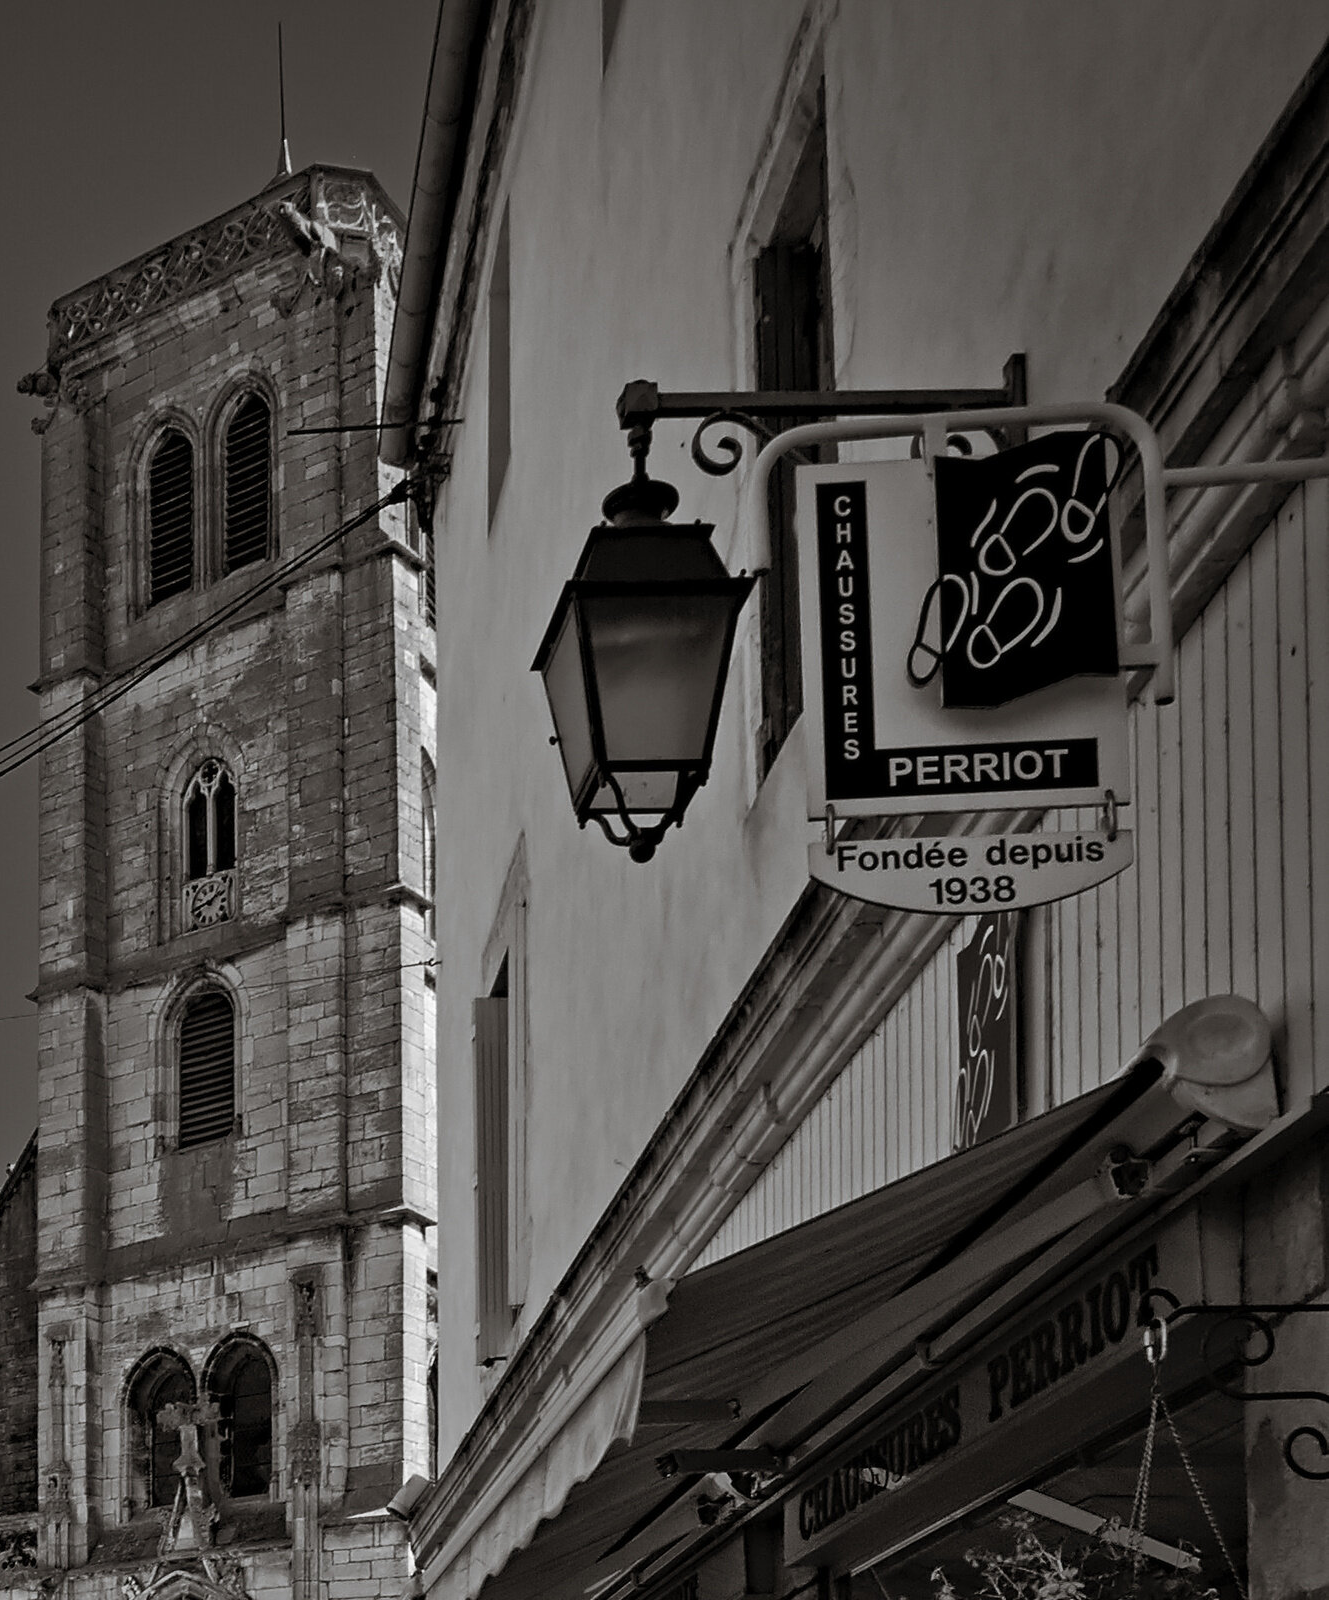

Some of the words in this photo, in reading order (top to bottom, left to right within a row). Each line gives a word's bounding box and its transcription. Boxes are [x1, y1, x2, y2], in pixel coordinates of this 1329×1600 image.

[832, 495, 862, 761] CHAUSSURES
[889, 749, 1069, 787] PERRIOT
[837, 839, 969, 873] Fondée
[985, 837, 1106, 871] depuis
[928, 876, 1017, 905] 1938
[799, 1385, 961, 1541] CHAUSSURES
[987, 1243, 1160, 1423] PERRIOT
